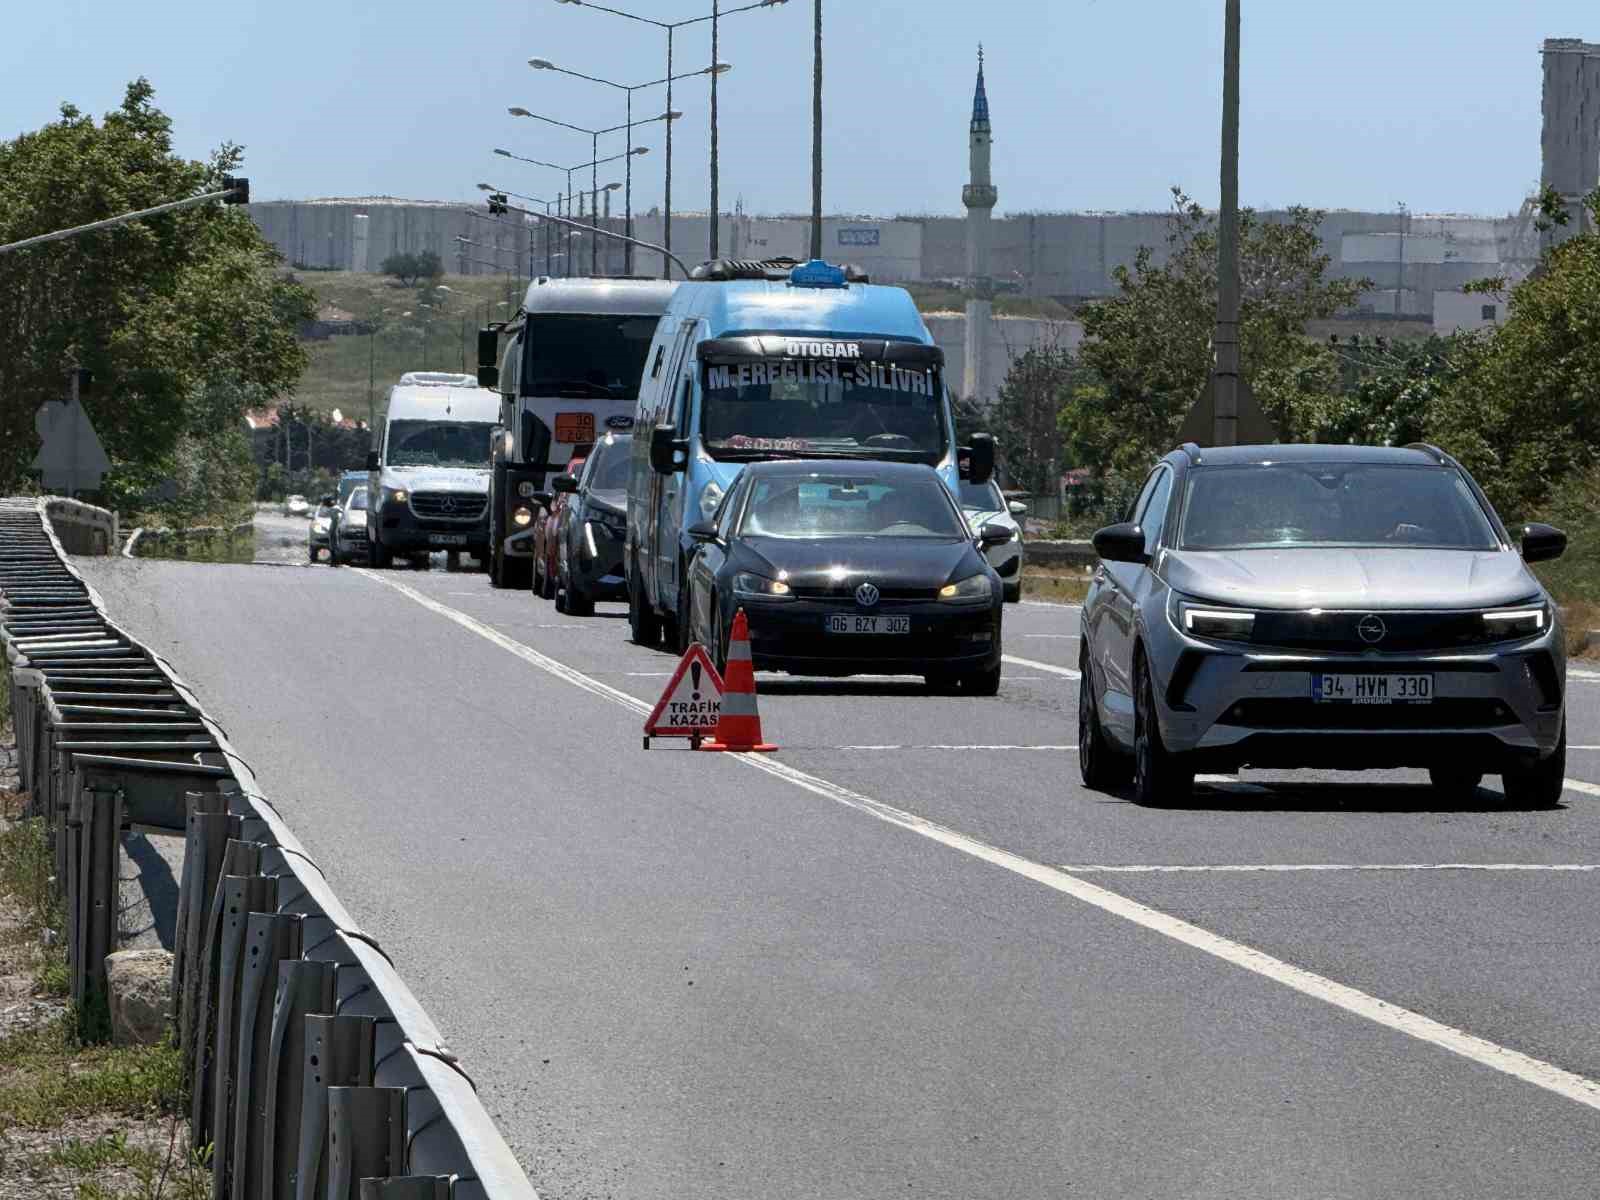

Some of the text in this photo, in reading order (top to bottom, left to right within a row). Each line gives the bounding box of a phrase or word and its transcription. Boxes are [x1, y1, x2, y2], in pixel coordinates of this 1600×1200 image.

[786, 341, 860, 358] OTOGAR
[832, 616, 848, 632] 06
[855, 616, 877, 633] BZY
[1323, 676, 1344, 696] 34
[1355, 676, 1388, 697] HVM
[1398, 677, 1429, 697] 330
[670, 700, 721, 713] TRAFİK
[670, 714, 721, 726] KAZAS
